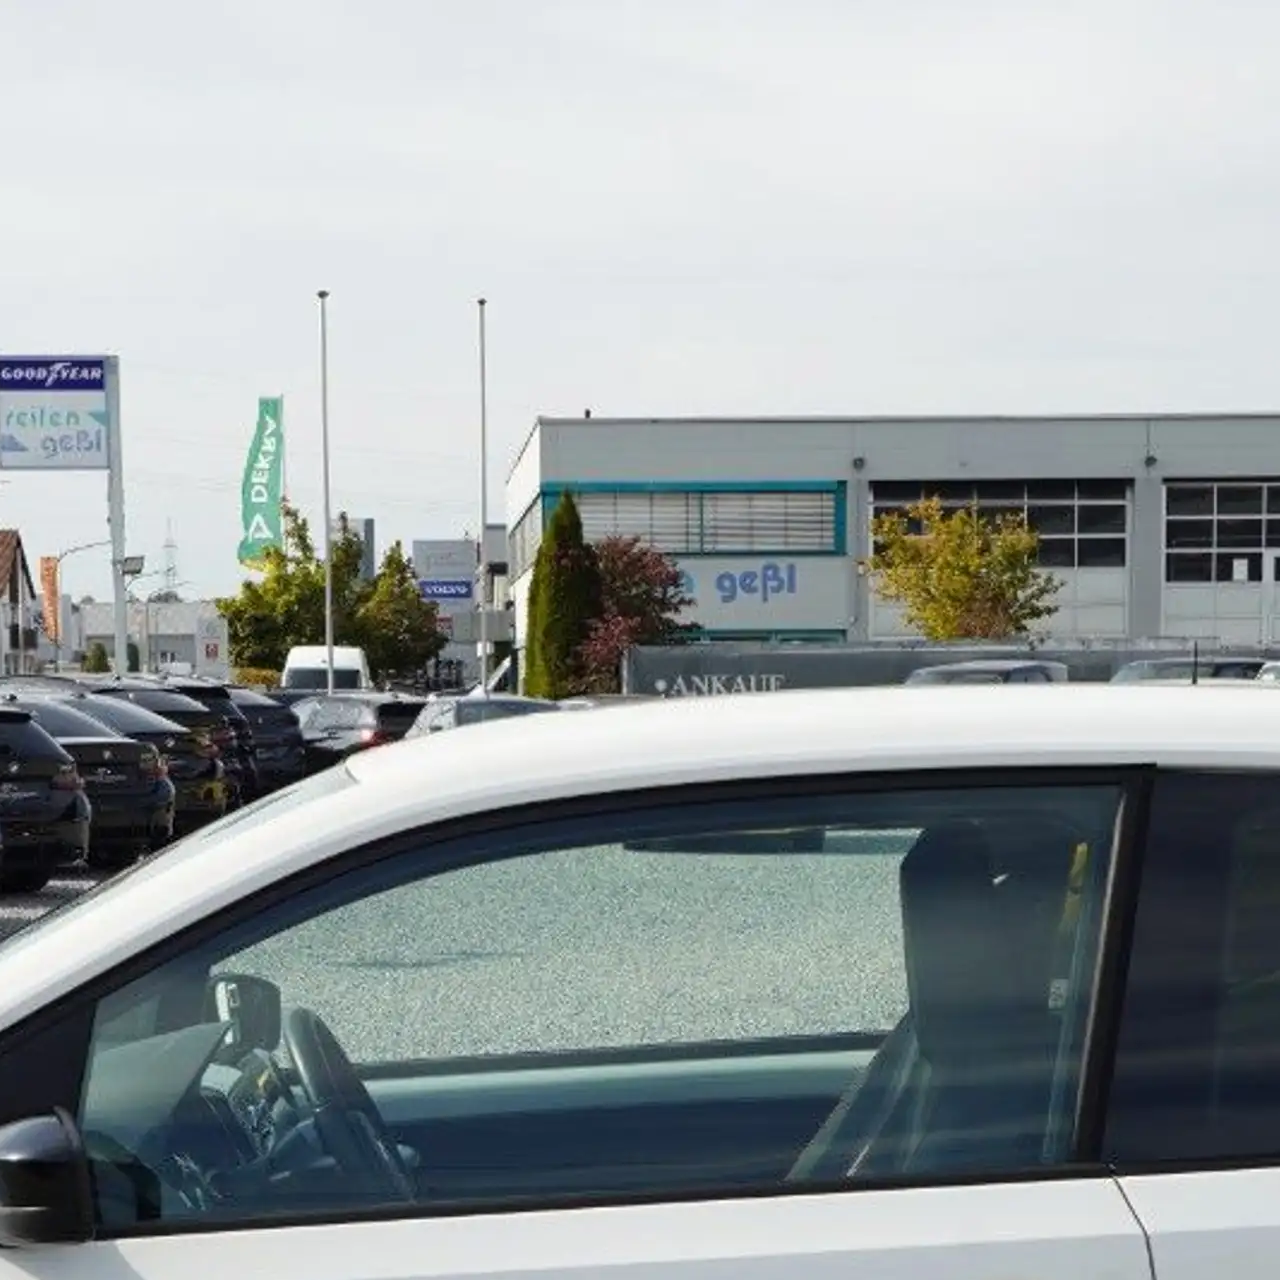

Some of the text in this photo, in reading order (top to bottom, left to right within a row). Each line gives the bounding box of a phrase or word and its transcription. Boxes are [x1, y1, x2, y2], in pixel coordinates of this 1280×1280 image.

[0, 362, 102, 387] GOODYEAR
[250, 413, 277, 503] DEKRA
[424, 585, 469, 595] VOLVO
[716, 562, 796, 604] geßl
[670, 674, 785, 697] ANKAUF
